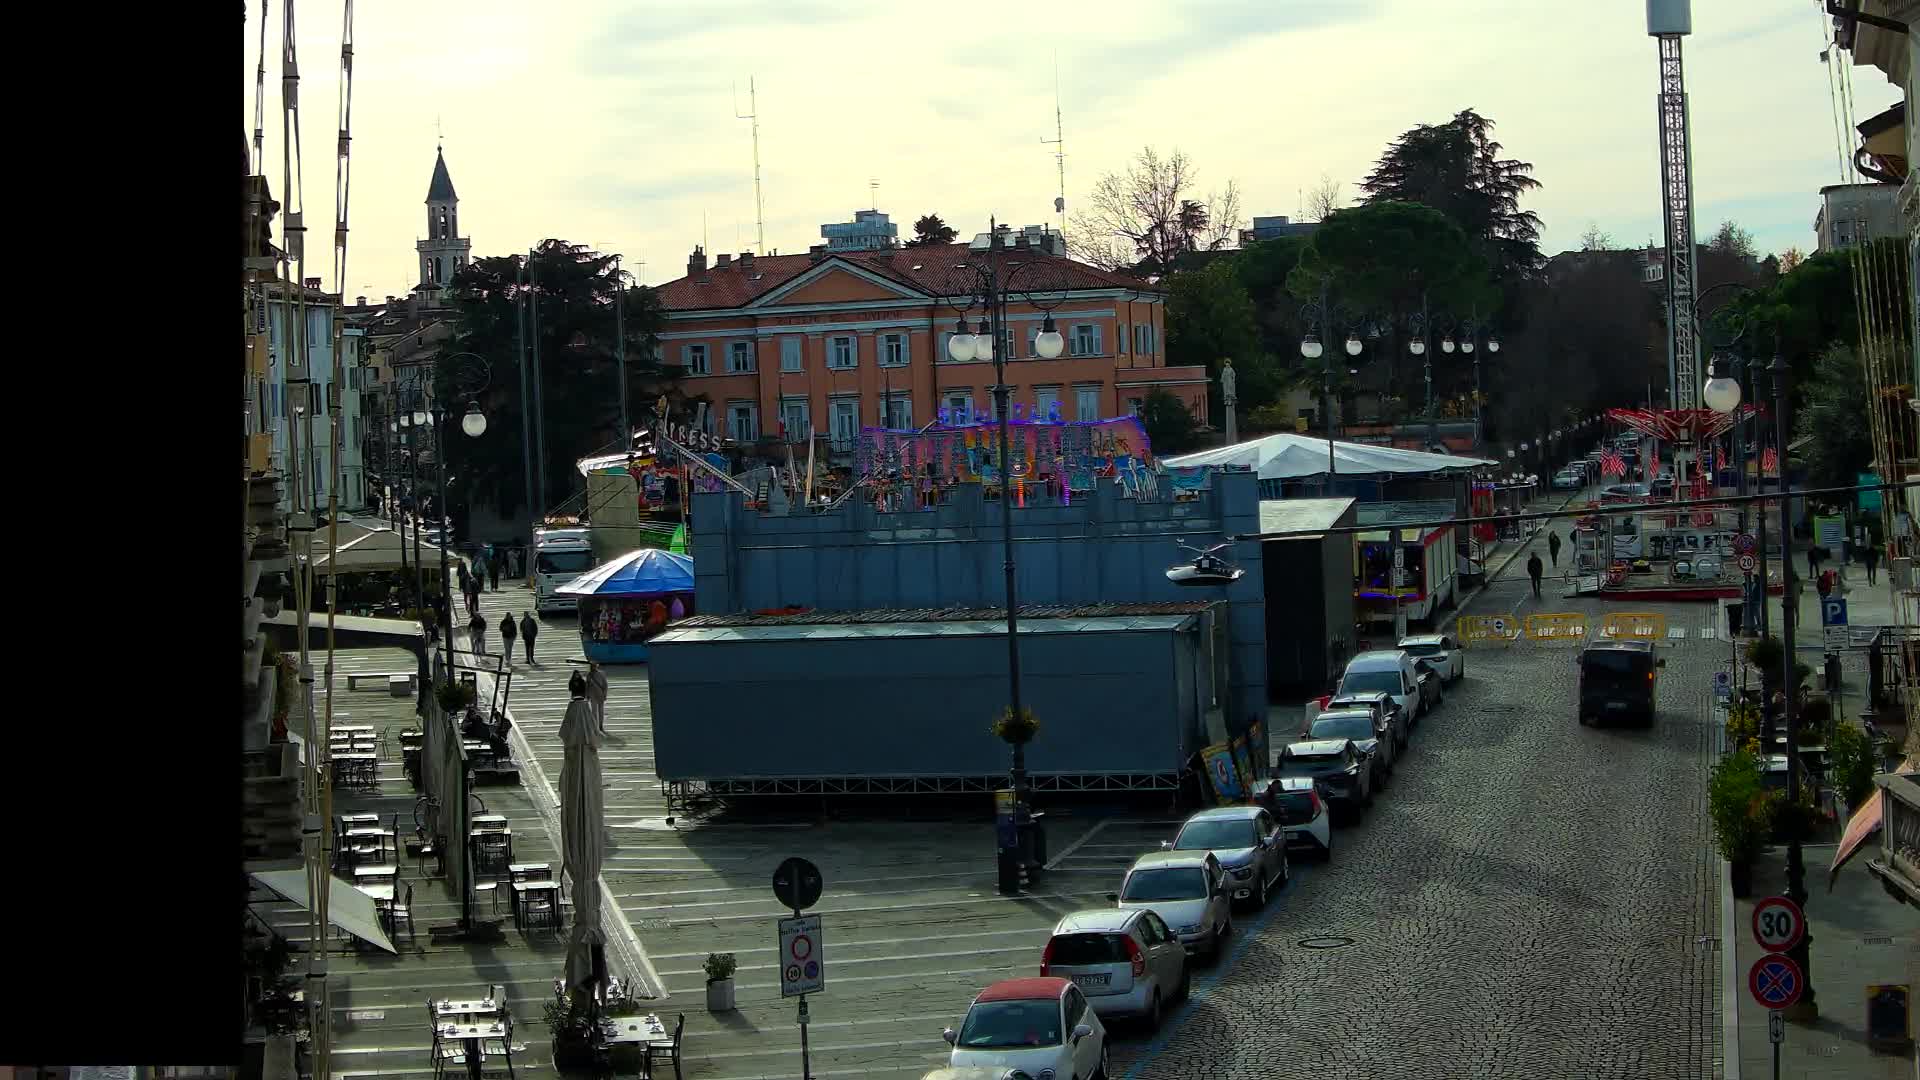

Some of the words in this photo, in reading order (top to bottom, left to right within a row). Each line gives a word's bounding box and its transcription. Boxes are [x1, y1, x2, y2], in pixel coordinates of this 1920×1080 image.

[1742, 558, 1752, 567] 20
[1826, 602, 1842, 622] P
[1761, 912, 1792, 937] 30
